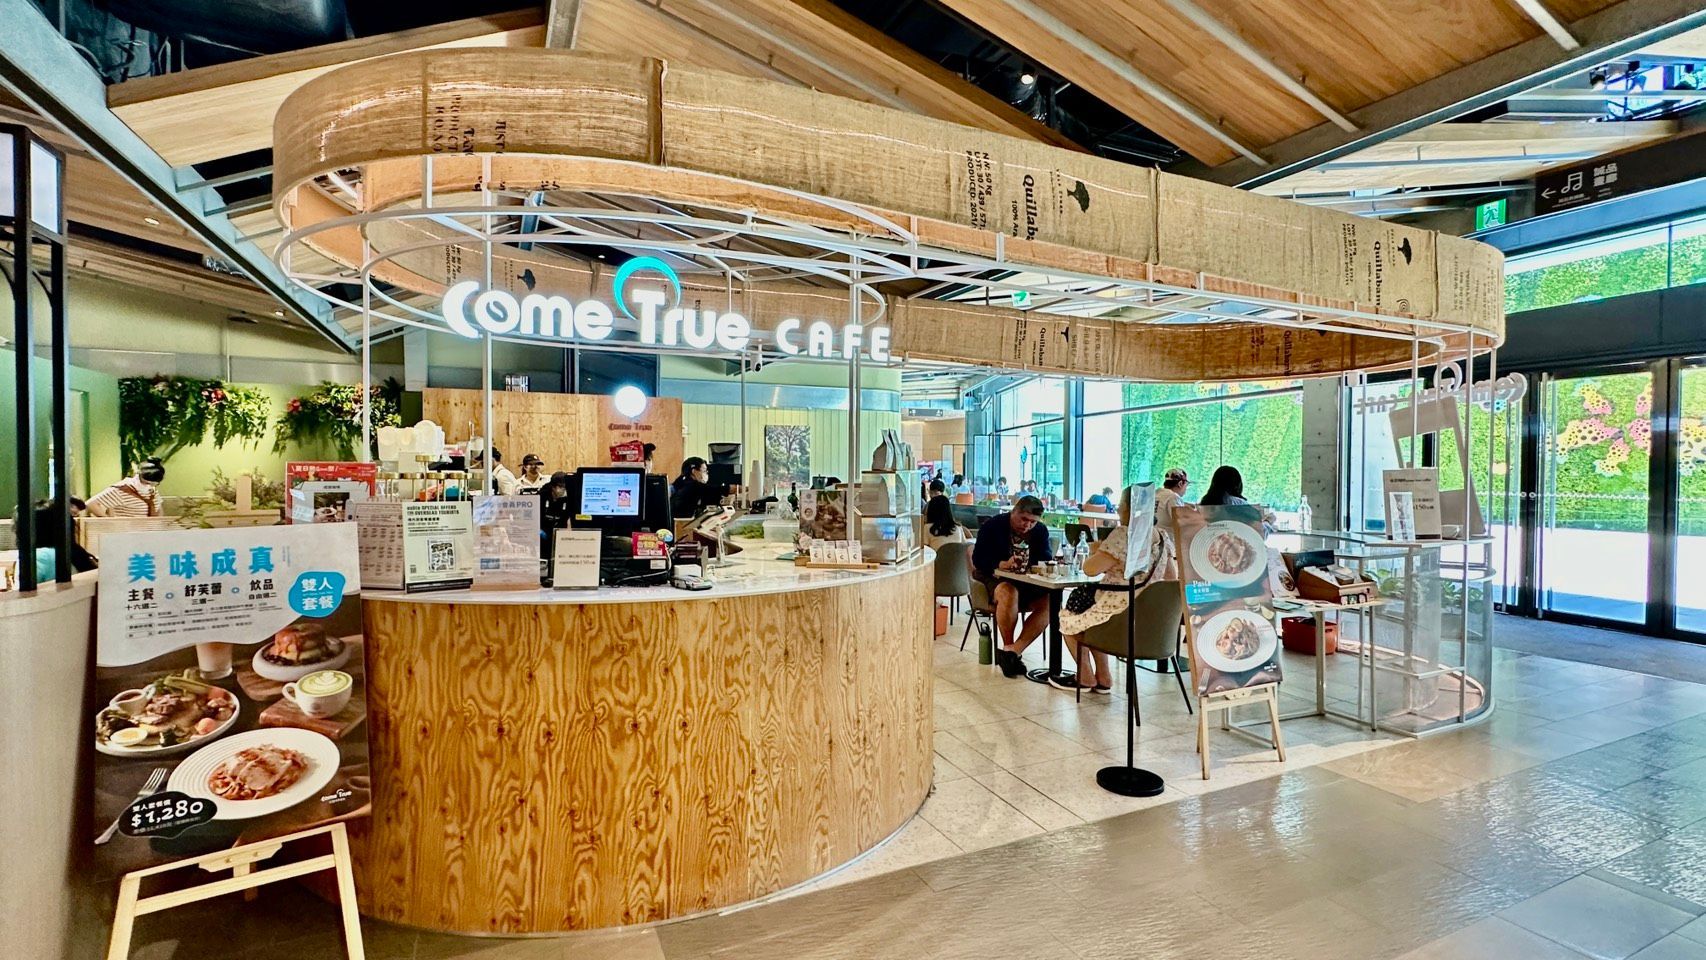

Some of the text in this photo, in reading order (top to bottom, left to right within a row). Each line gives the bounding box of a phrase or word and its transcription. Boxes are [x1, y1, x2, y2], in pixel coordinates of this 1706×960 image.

[442, 280, 892, 363] Come True CAFE
[127, 546, 275, 584] 美味成真
[128, 578, 274, 602] 主餐 舒芙蕾 飲品
[301, 576, 334, 593] 雙人
[302, 595, 334, 612] 套餐
[131, 799, 204, 828] $1,280
